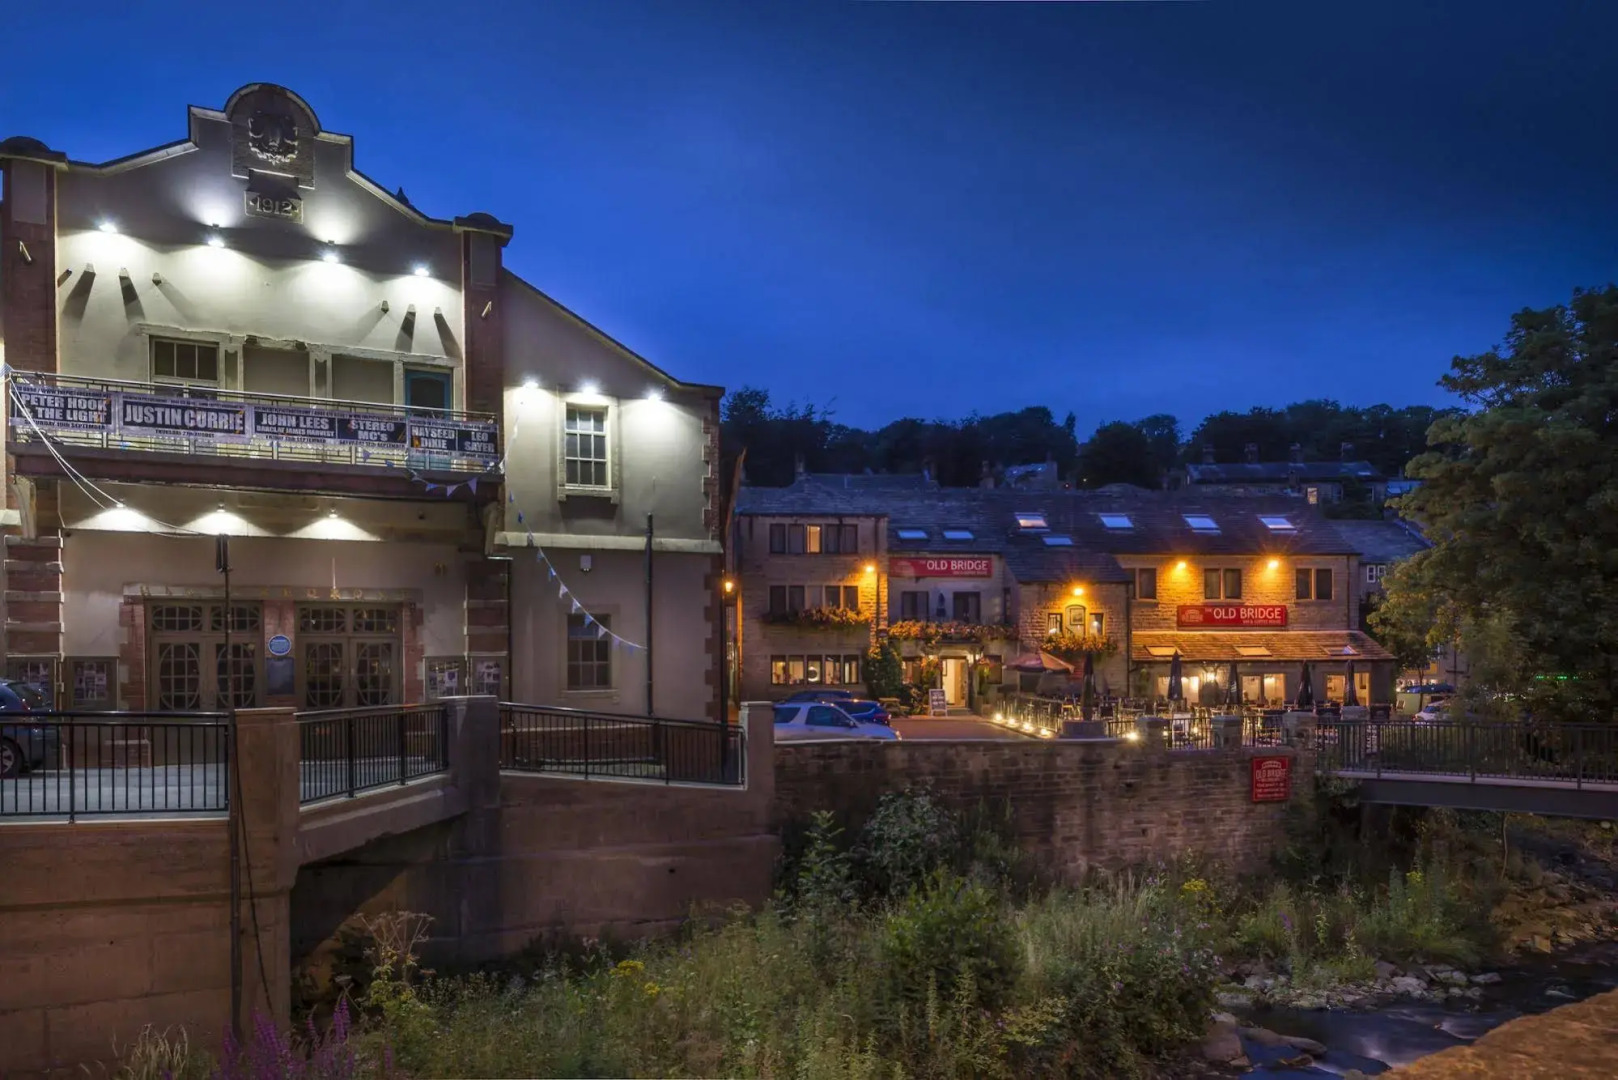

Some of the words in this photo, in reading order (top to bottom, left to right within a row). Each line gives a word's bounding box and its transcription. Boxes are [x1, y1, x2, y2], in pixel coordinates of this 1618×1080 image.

[256, 196, 293, 216] 1912
[20, 393, 65, 408] PETER
[67, 397, 107, 411] HOOK
[35, 407, 64, 420] THE
[66, 409, 107, 423] LIGHT
[125, 404, 182, 425] JUSTIN
[184, 409, 244, 431] CURRIE
[261, 413, 297, 427] JOHN
[299, 416, 330, 430] LEES
[256, 425, 284, 433] BARCLAY
[285, 427, 306, 436] JAMES
[306, 429, 335, 438] HARVEST
[351, 419, 395, 432] STEREO
[358, 430, 388, 442] MC's
[411, 426, 455, 440] HAYSEED
[471, 431, 489, 442] LEO
[420, 437, 448, 449] DIXIE
[464, 440, 496, 453] SAYER
[927, 560, 948, 570] OLD
[951, 560, 988, 570] BRIDGE
[1213, 607, 1237, 619] OLD
[1240, 607, 1282, 619] BRIDGE
